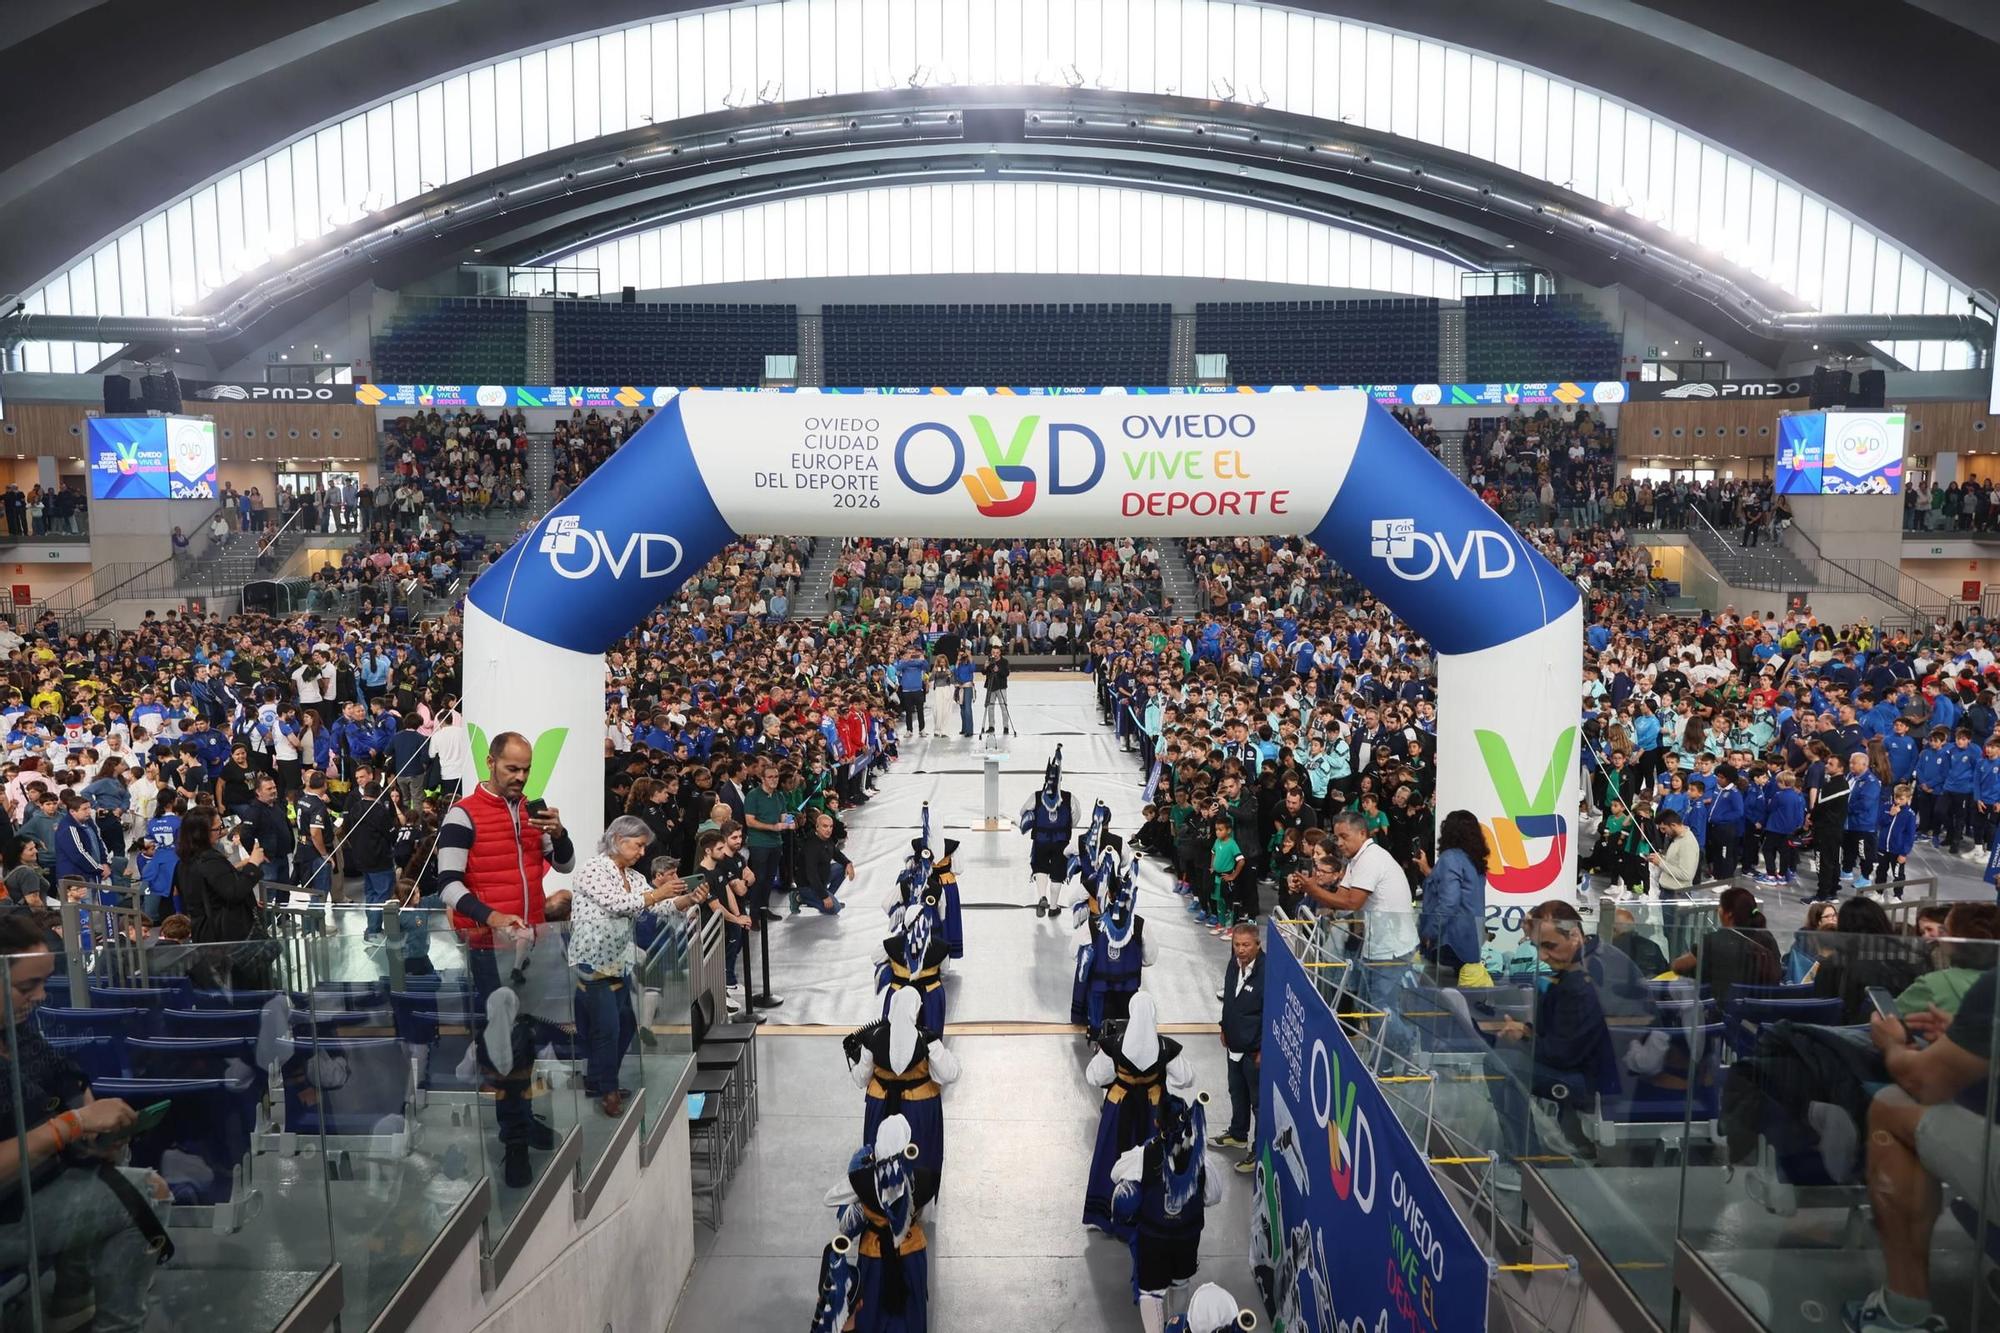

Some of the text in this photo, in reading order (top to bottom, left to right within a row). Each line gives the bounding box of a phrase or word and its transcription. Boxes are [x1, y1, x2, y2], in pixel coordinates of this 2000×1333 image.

[805, 417, 880, 432] OVIEDO
[1122, 414, 1256, 439] OVIEDO
[804, 434, 879, 451] CIUDAD
[791, 453, 879, 471] EUROPEA
[1122, 450, 1250, 480] VIVE EL
[755, 472, 880, 491] DEL DEPORTE
[833, 493, 880, 509] 2026
[1121, 490, 1290, 517] DEPORTE
[550, 528, 684, 580] OVD
[1386, 529, 1516, 582] OVD
[1286, 983, 1305, 1023] OVIEDO
[1391, 1170, 1444, 1282] OVIEDO
[1388, 1211, 1438, 1331] VIVE EL
